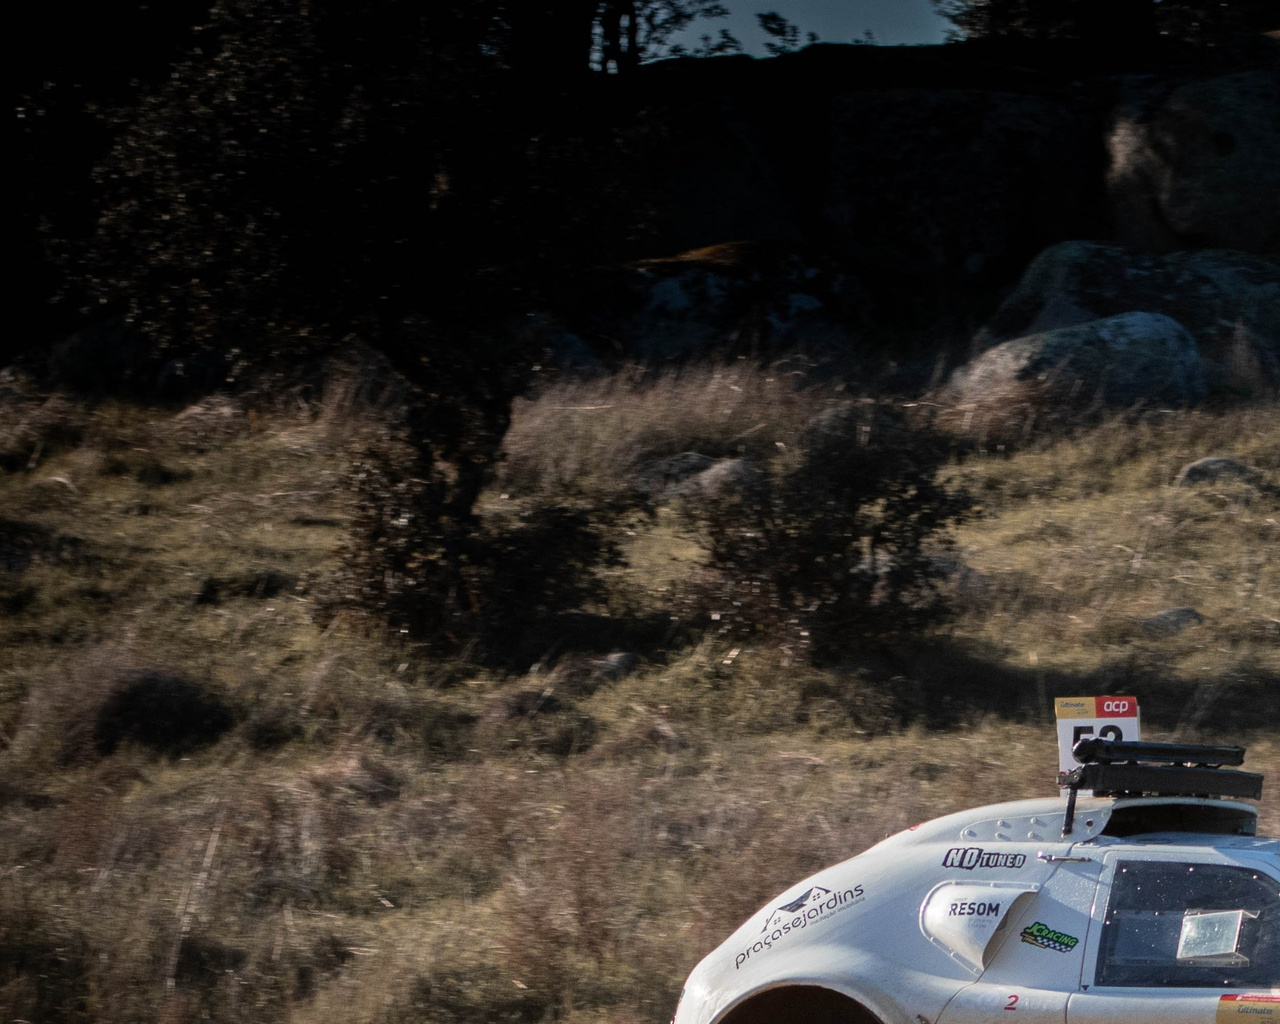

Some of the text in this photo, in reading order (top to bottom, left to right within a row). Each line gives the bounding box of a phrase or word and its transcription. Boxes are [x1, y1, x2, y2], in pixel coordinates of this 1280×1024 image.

[1103, 701, 1129, 713] acp
[980, 853, 1026, 868] TUNED
[948, 902, 1000, 917] RESOM
[735, 884, 865, 969] praçasejardins
[1004, 994, 1019, 1011] 2
